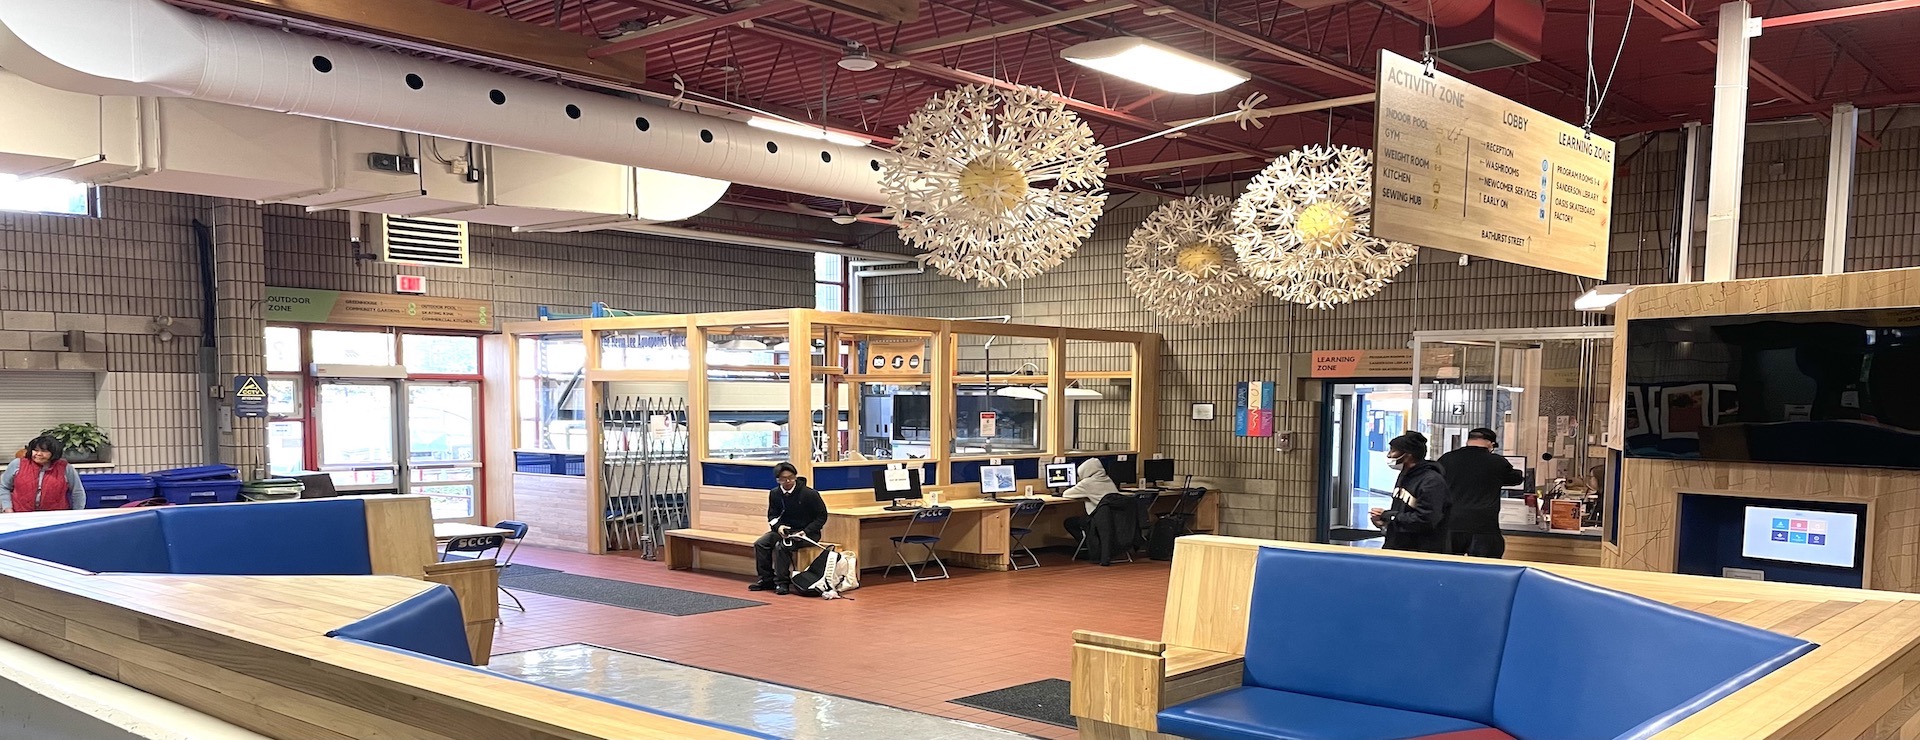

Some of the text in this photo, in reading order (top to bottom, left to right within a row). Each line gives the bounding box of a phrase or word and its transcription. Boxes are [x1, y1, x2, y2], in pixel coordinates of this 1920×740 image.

[1388, 66, 1464, 108] ACTIVITY ZONE
[1386, 107, 1428, 130] INDOOR POOL
[1503, 110, 1529, 132] LOBBY
[1385, 128, 1400, 141] GYM
[1486, 142, 1514, 158] RECEPTION
[1559, 132, 1611, 163] LEARNING ZONE
[1384, 148, 1430, 170] WEIGHT ROOM
[1383, 167, 1411, 183] KITCHEN
[1485, 160, 1520, 177] WASHROOMS
[1557, 165, 1579, 179] PROGRAM
[1579, 172, 1594, 185] ROOMS
[1382, 187, 1422, 206] SEWING HUB
[1484, 177, 1538, 200] NEWCOMER SERVICES
[1556, 182, 1599, 202] SANDERSON LIBRARY
[1483, 194, 1508, 209] EARLY ON
[1555, 198, 1596, 216] OASIS SKATEBOARD
[1554, 212, 1574, 224] FACTORY
[1482, 230, 1525, 246] BATHURST STREET
[267, 296, 311, 304] OUTDOOR
[1454, 404, 1462, 415] 2
[920, 510, 942, 518] SCCC
[458, 536, 493, 548] SCCC
